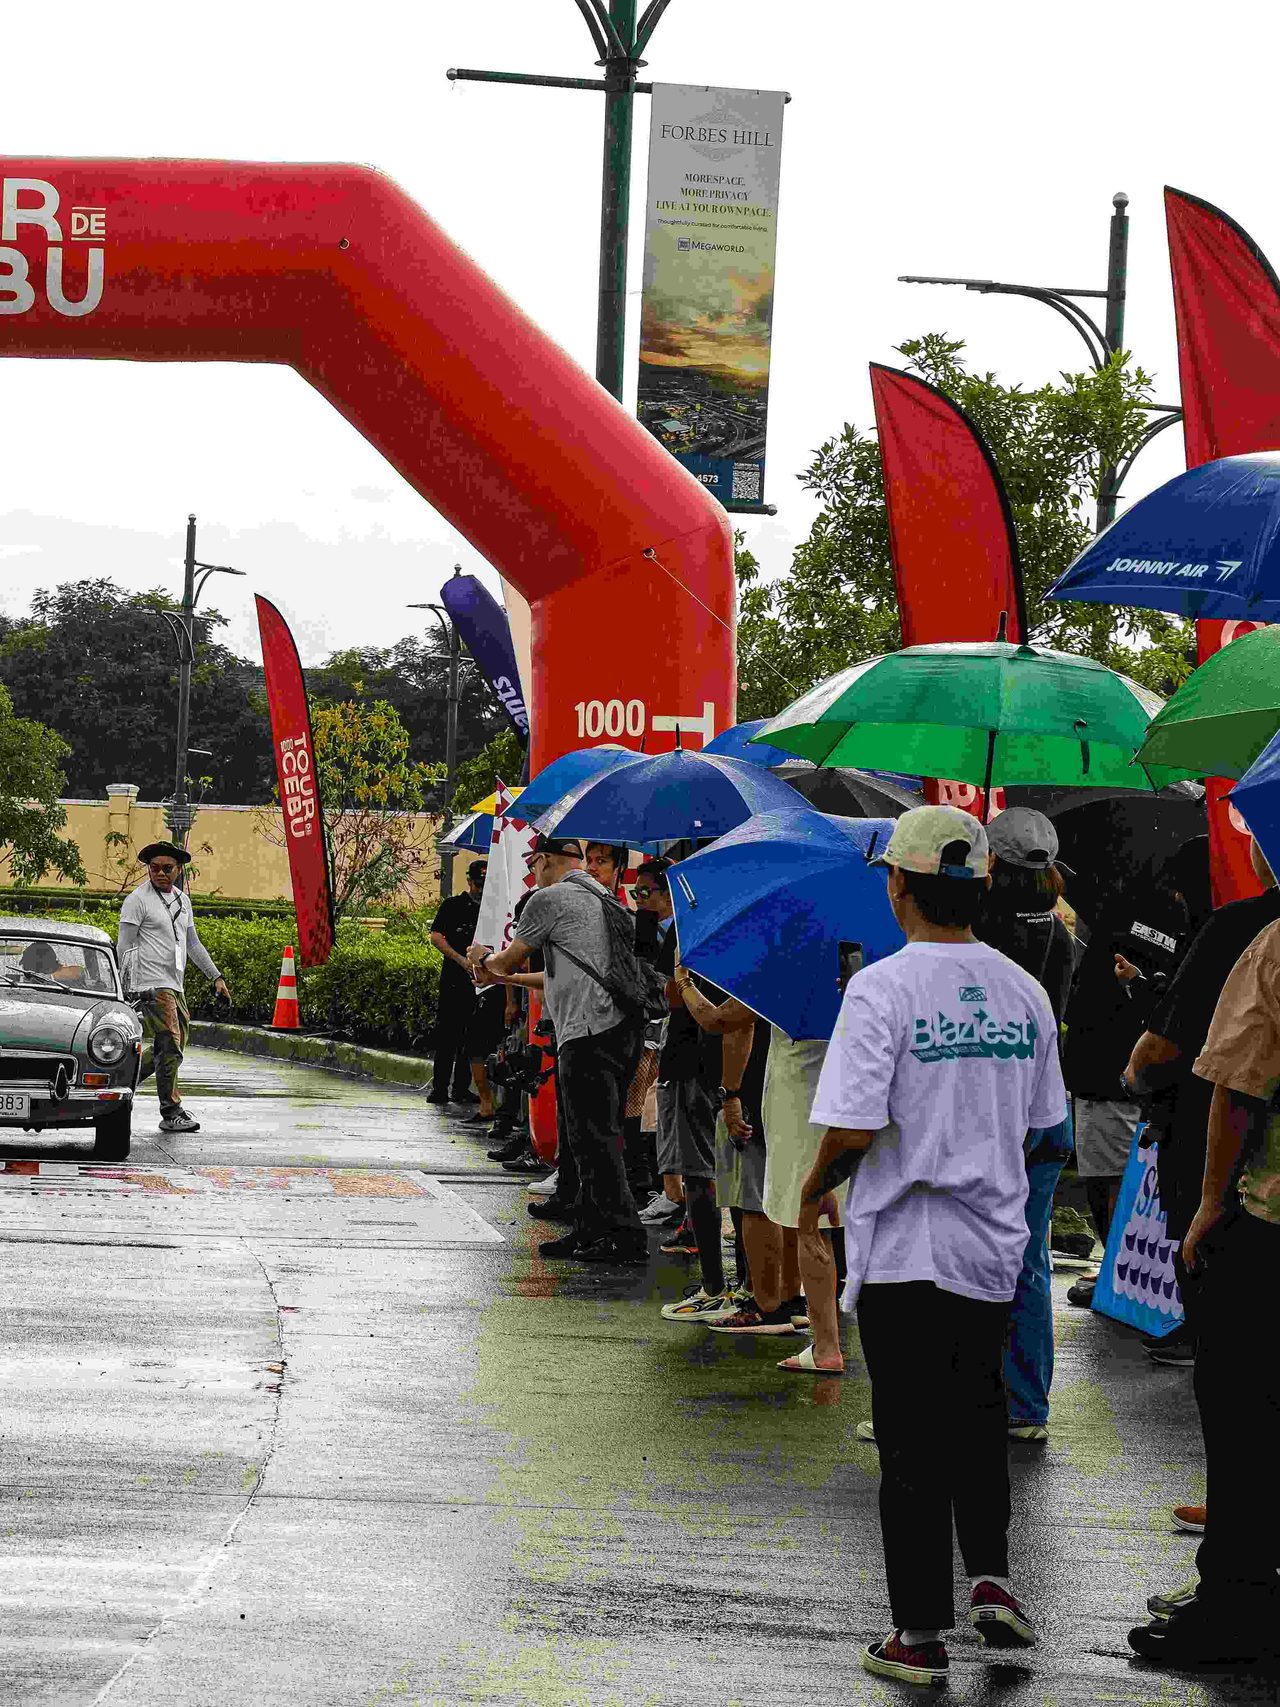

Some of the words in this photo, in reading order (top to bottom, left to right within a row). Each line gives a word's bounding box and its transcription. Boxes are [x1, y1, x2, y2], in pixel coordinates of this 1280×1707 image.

[661, 124, 727, 144] FORBES
[733, 130, 774, 147] HILL
[685, 173, 713, 184] MORE
[680, 187, 709, 199] MORE
[656, 200, 677, 210] LIVE
[71, 212, 106, 236] DE
[691, 240, 745, 253] MEGAWORLD
[1106, 558, 1180, 575] JOHNNY
[1175, 563, 1209, 578] AIR
[574, 699, 645, 738] 1000
[294, 731, 315, 822] TOUR
[282, 751, 305, 838] CEBU
